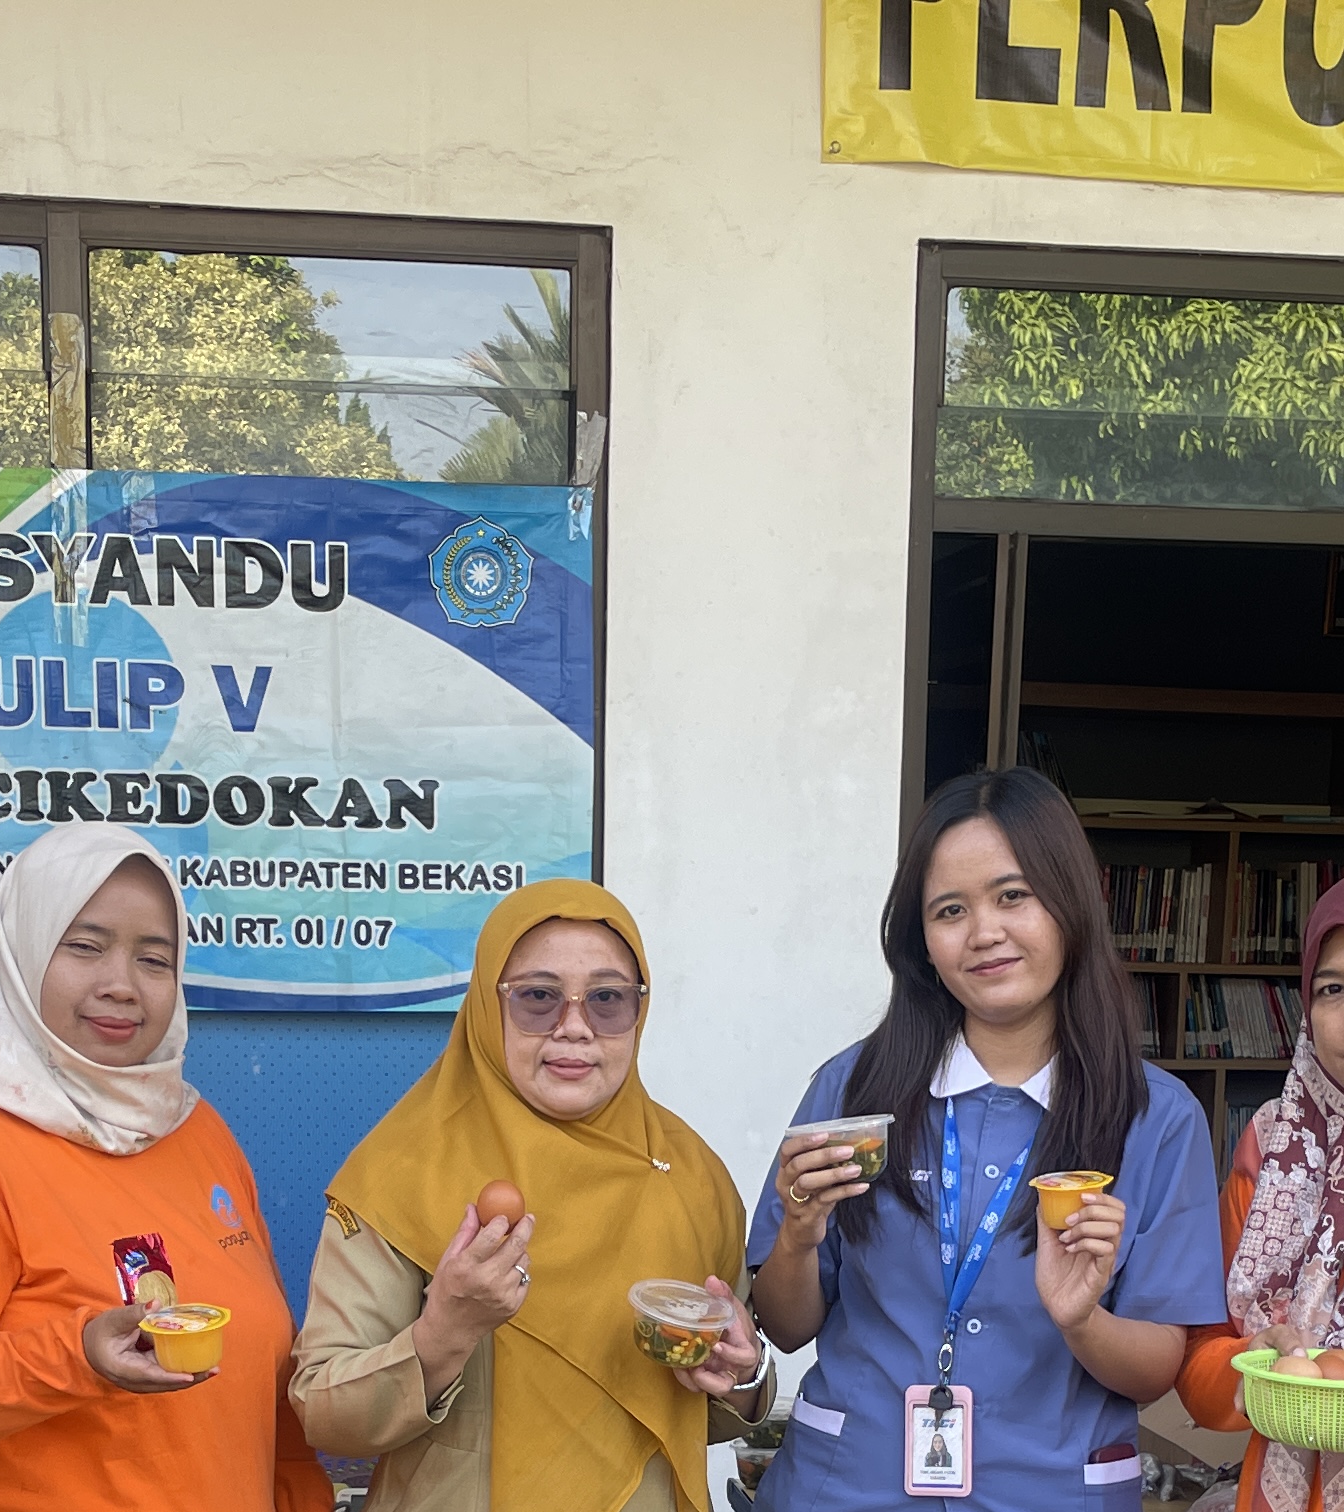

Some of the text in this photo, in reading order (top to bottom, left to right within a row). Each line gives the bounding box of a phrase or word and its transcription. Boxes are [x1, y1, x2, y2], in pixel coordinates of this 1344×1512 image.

[212, 665, 272, 732] V
[180, 858, 523, 891] KABUPATEN BEKASI
[236, 919, 284, 947] RT.
[356, 920, 394, 948] 07
